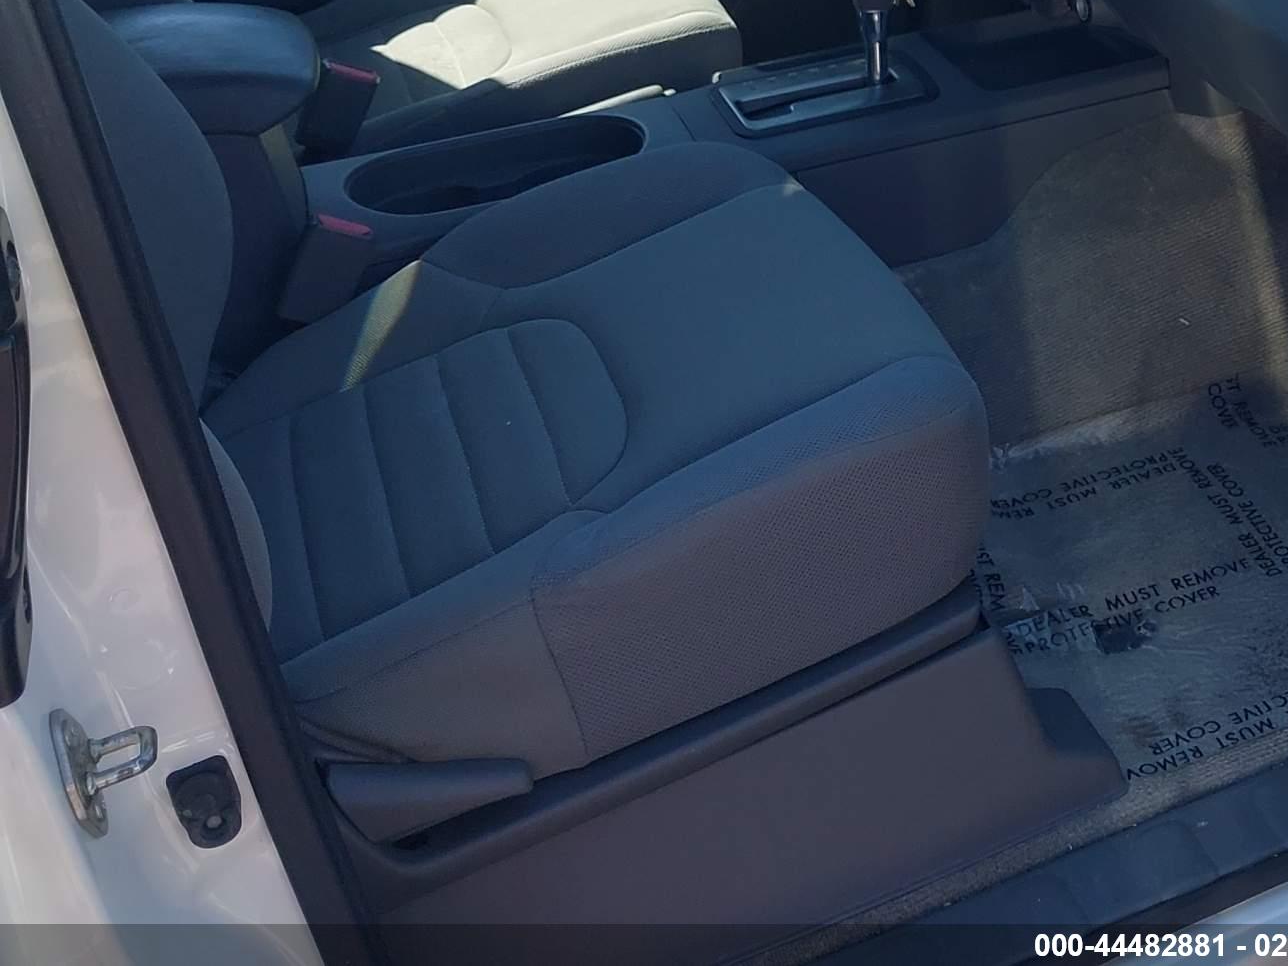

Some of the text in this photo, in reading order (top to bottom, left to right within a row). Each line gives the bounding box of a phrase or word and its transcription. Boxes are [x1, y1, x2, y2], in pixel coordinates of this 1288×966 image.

[1062, 451, 1168, 493] PROTECTIVE
[1110, 461, 1177, 491] DEALER
[1204, 462, 1244, 496] COVER
[1047, 486, 1098, 510] MUST
[1166, 446, 1283, 577] DEALER MUST REMOVE
[1016, 557, 1250, 638] DEALER MUST REMOVE
[1154, 584, 1220, 613] COVER
[1147, 719, 1222, 756] COVER
[1214, 716, 1274, 749] MUST
[1125, 744, 1203, 782] REMOV
